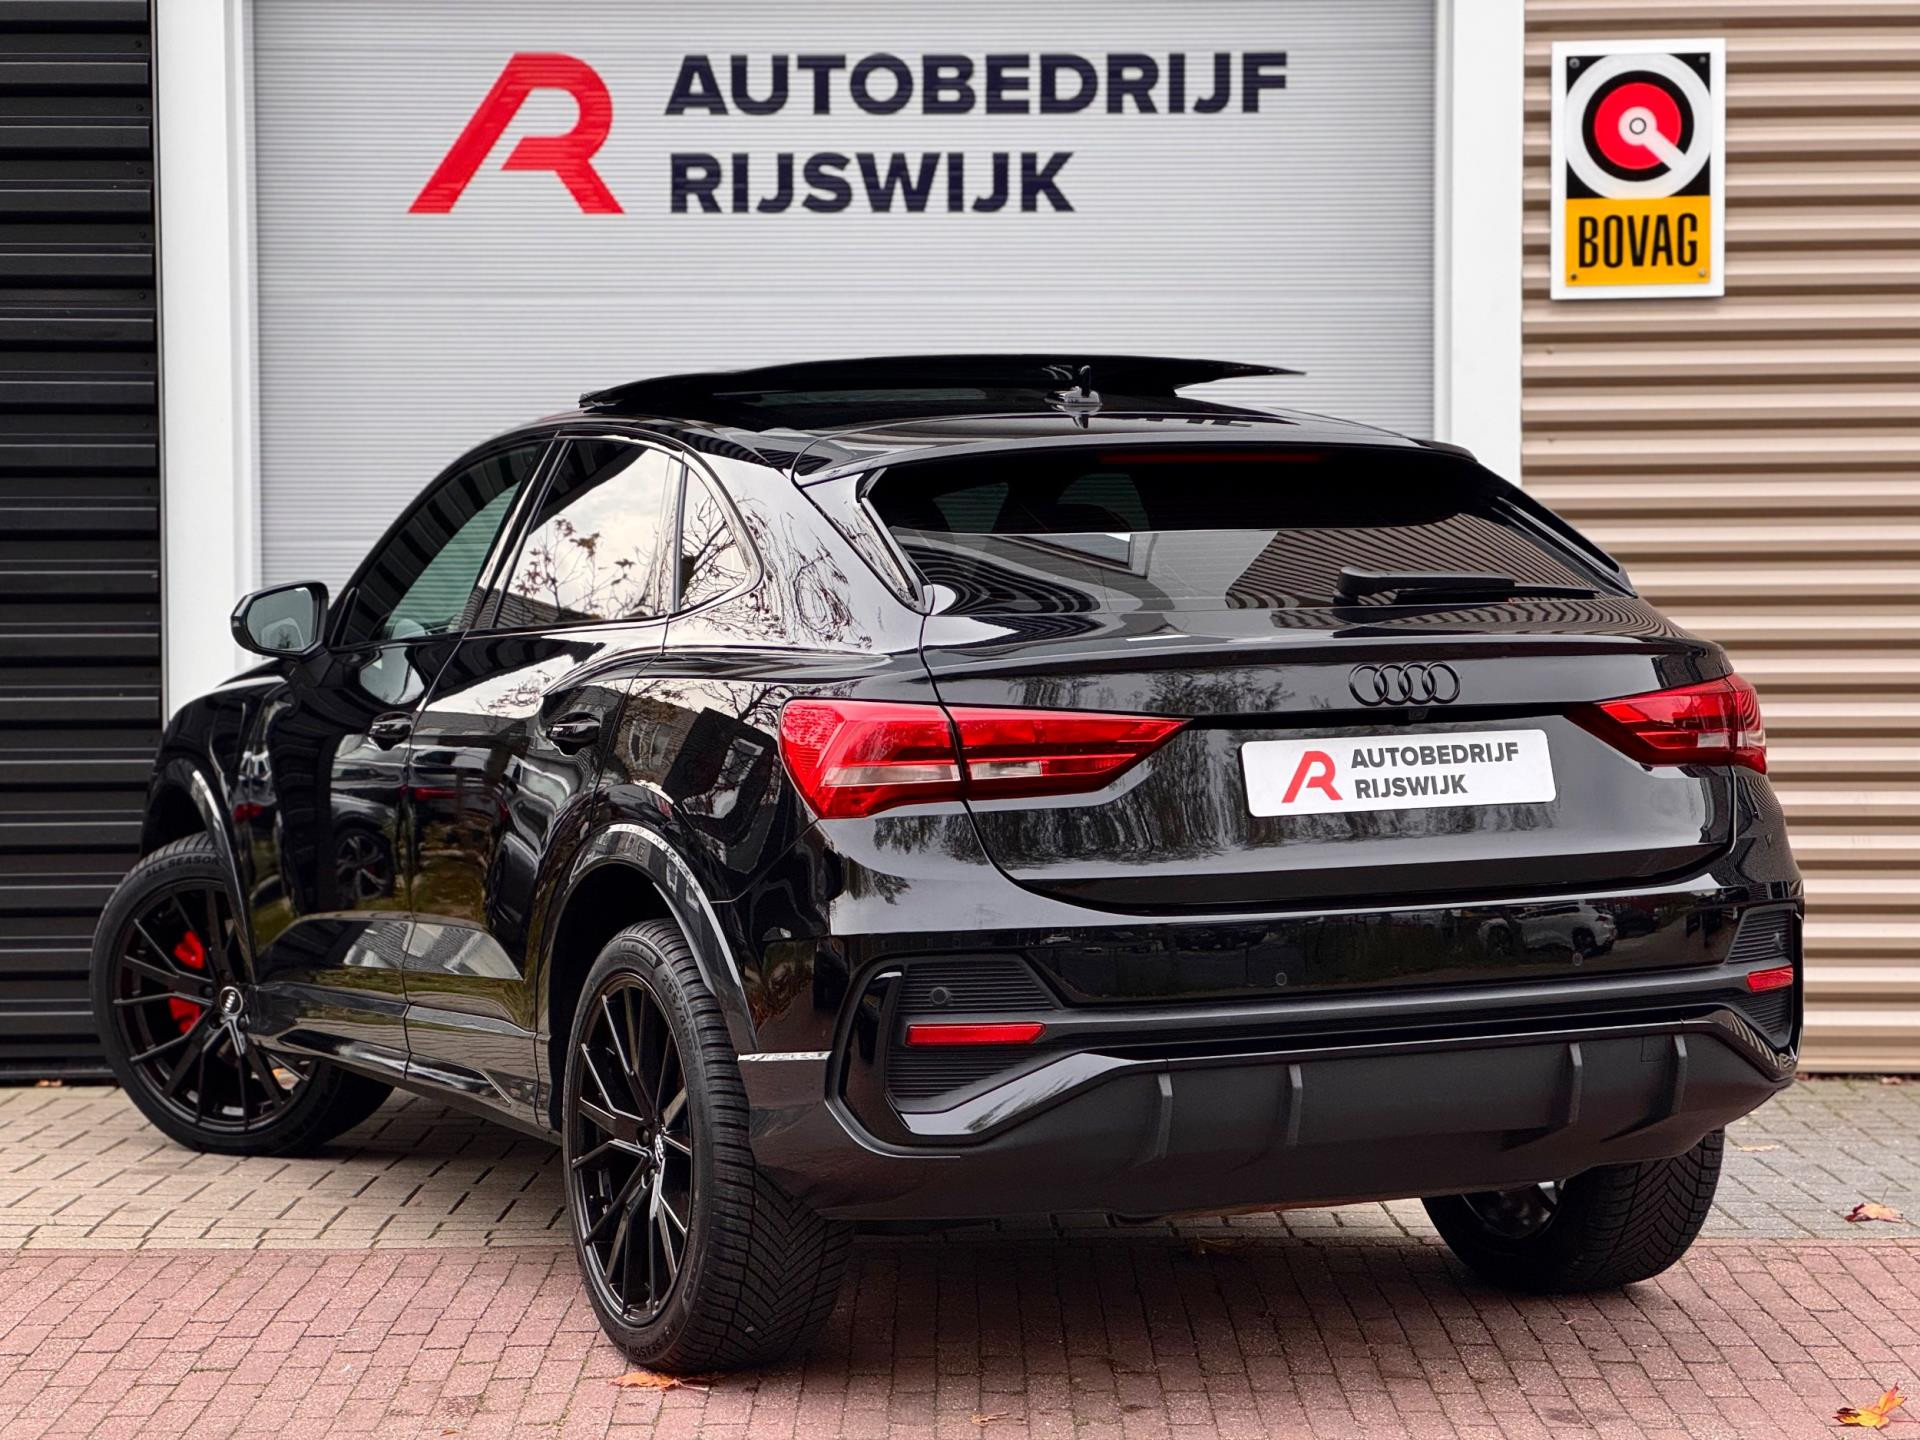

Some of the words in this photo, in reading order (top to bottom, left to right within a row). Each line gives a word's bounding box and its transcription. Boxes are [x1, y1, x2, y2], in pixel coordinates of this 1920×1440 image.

[665, 52, 1287, 115] AUTOBEDRIJF
[671, 152, 1074, 213] RIJSWIJK
[1579, 213, 1697, 268] BOVAG
[1351, 742, 1519, 769] AUTOBEDRIJF
[1355, 774, 1468, 799] RIJSWIJK
[145, 864, 165, 879] ALL
